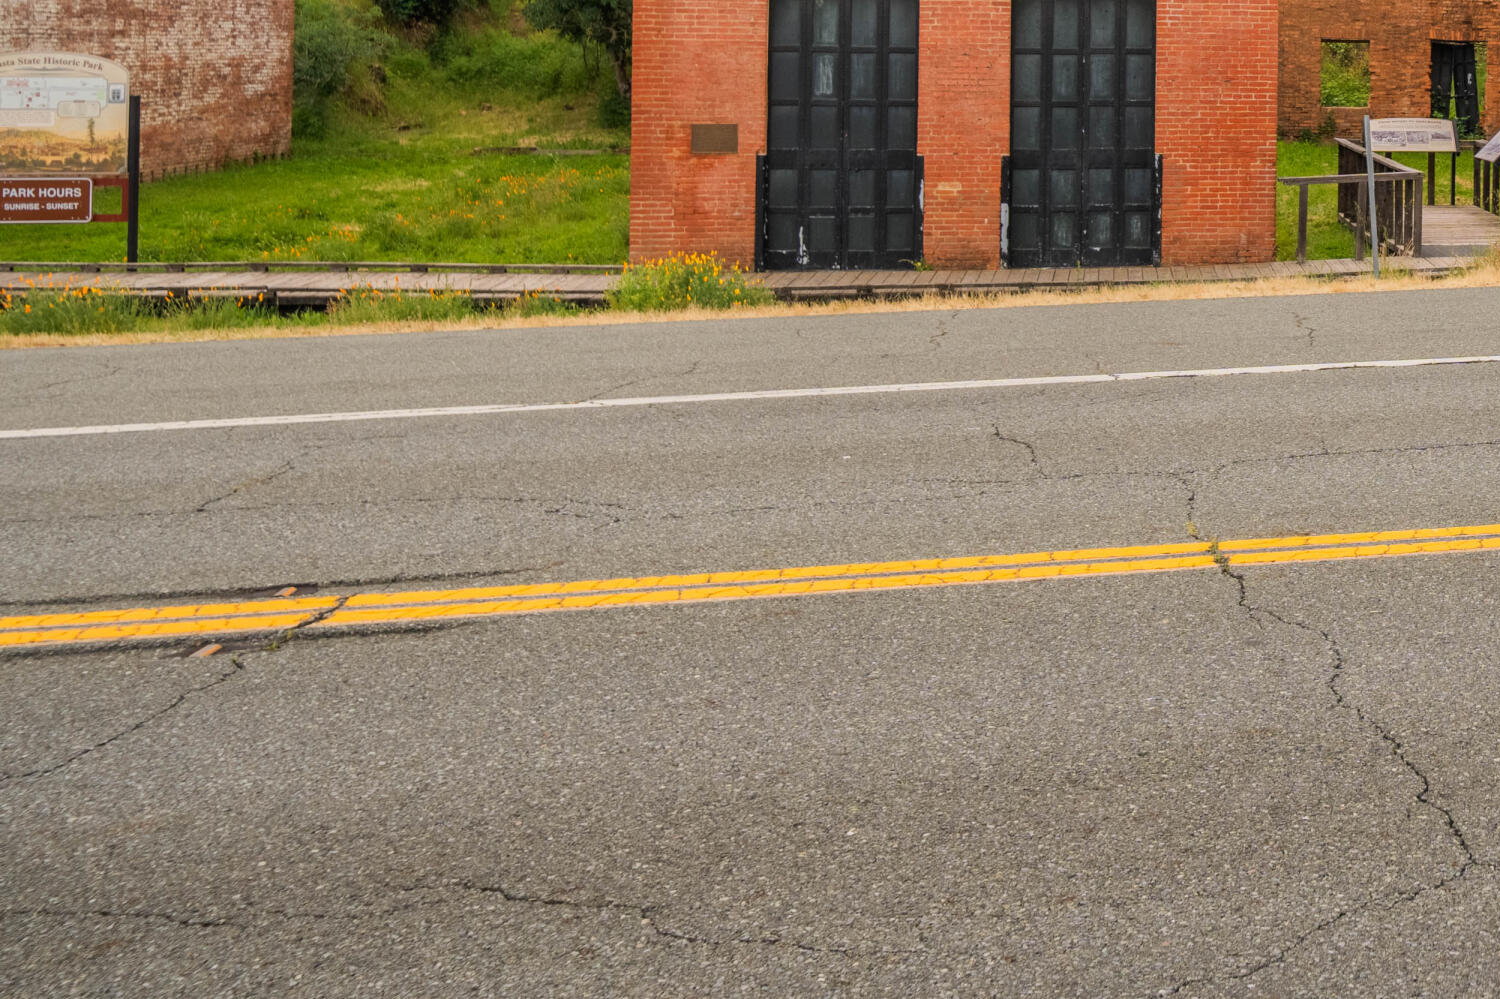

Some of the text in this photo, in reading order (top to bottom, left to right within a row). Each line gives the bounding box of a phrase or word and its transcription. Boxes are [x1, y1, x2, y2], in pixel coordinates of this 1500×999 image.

[17, 57, 41, 65] State
[43, 56, 81, 66] Historic
[83, 60, 103, 71] Park
[2, 187, 82, 198] PARK HOURS
[4, 202, 40, 211] SUNRISE
[46, 202, 79, 210] SUNSET
